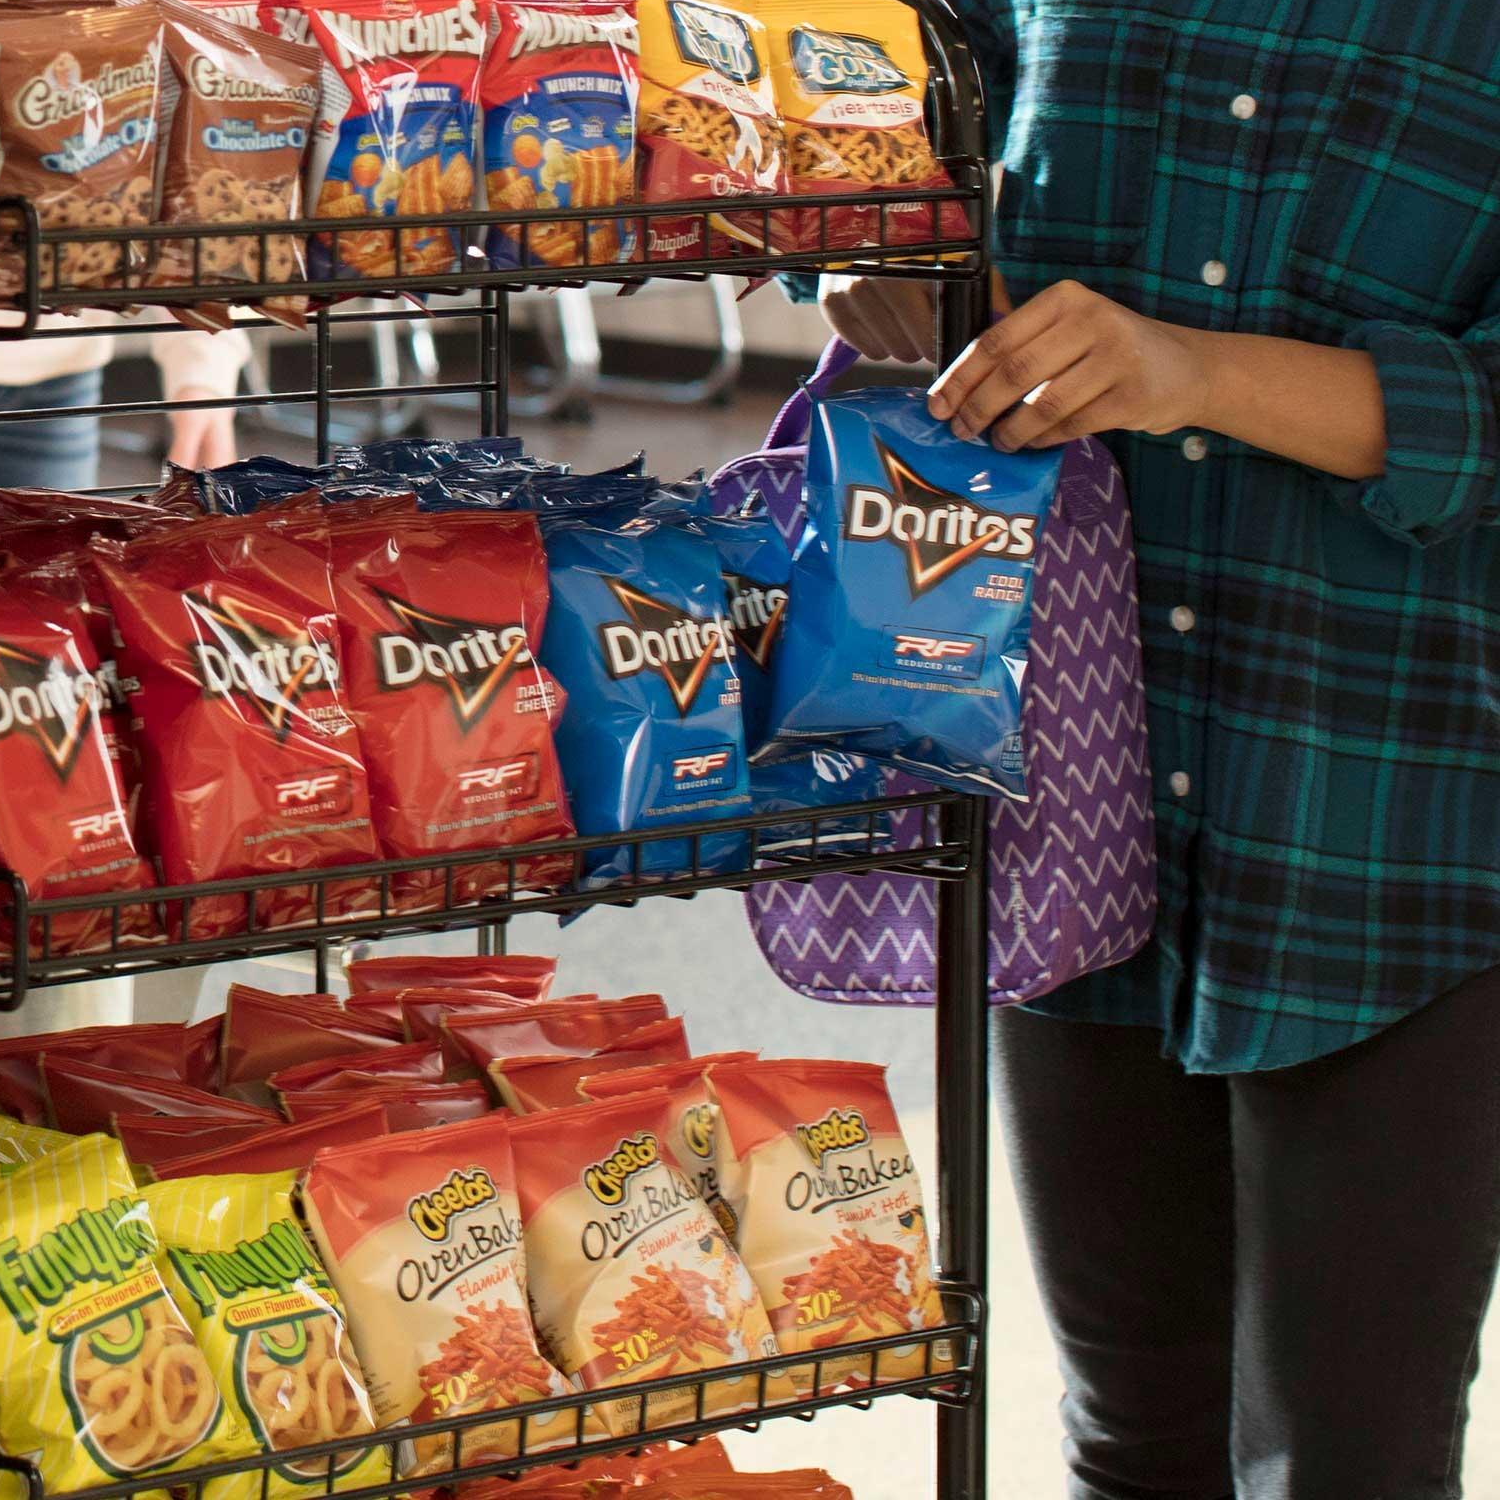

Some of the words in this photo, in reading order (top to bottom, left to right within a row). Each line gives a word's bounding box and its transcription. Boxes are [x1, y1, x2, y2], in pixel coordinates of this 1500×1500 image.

[545, 76, 596, 95] MUNCH
[597, 78, 622, 96] MIX
[203, 127, 287, 153] Chocolate
[849, 489, 1036, 555] Doritos
[972, 587, 1025, 603] RANCH
[986, 574, 1025, 588] COOL
[894, 635, 975, 660] RF
[896, 658, 943, 671] REDUCED
[944, 663, 964, 672] FAT
[457, 761, 527, 791] RF
[673, 753, 728, 781] RF
[276, 775, 340, 804] RF
[461, 791, 505, 805] REDUCED
[68, 809, 126, 839] RF
[586, 1134, 659, 1204] Cheetos
[409, 1170, 495, 1241] Cheetos
[881, 1190, 910, 1213] Hot
[581, 1202, 648, 1262] Oven
[683, 1215, 707, 1237] Hot
[397, 1243, 478, 1302] Oven
[93, 1281, 143, 1309] Flavored
[795, 1288, 842, 1326] 50%
[231, 1306, 263, 1323] Onion
[264, 1296, 308, 1313] Flavored
[611, 1329, 658, 1371] 50%
[431, 1371, 479, 1415] 50%
